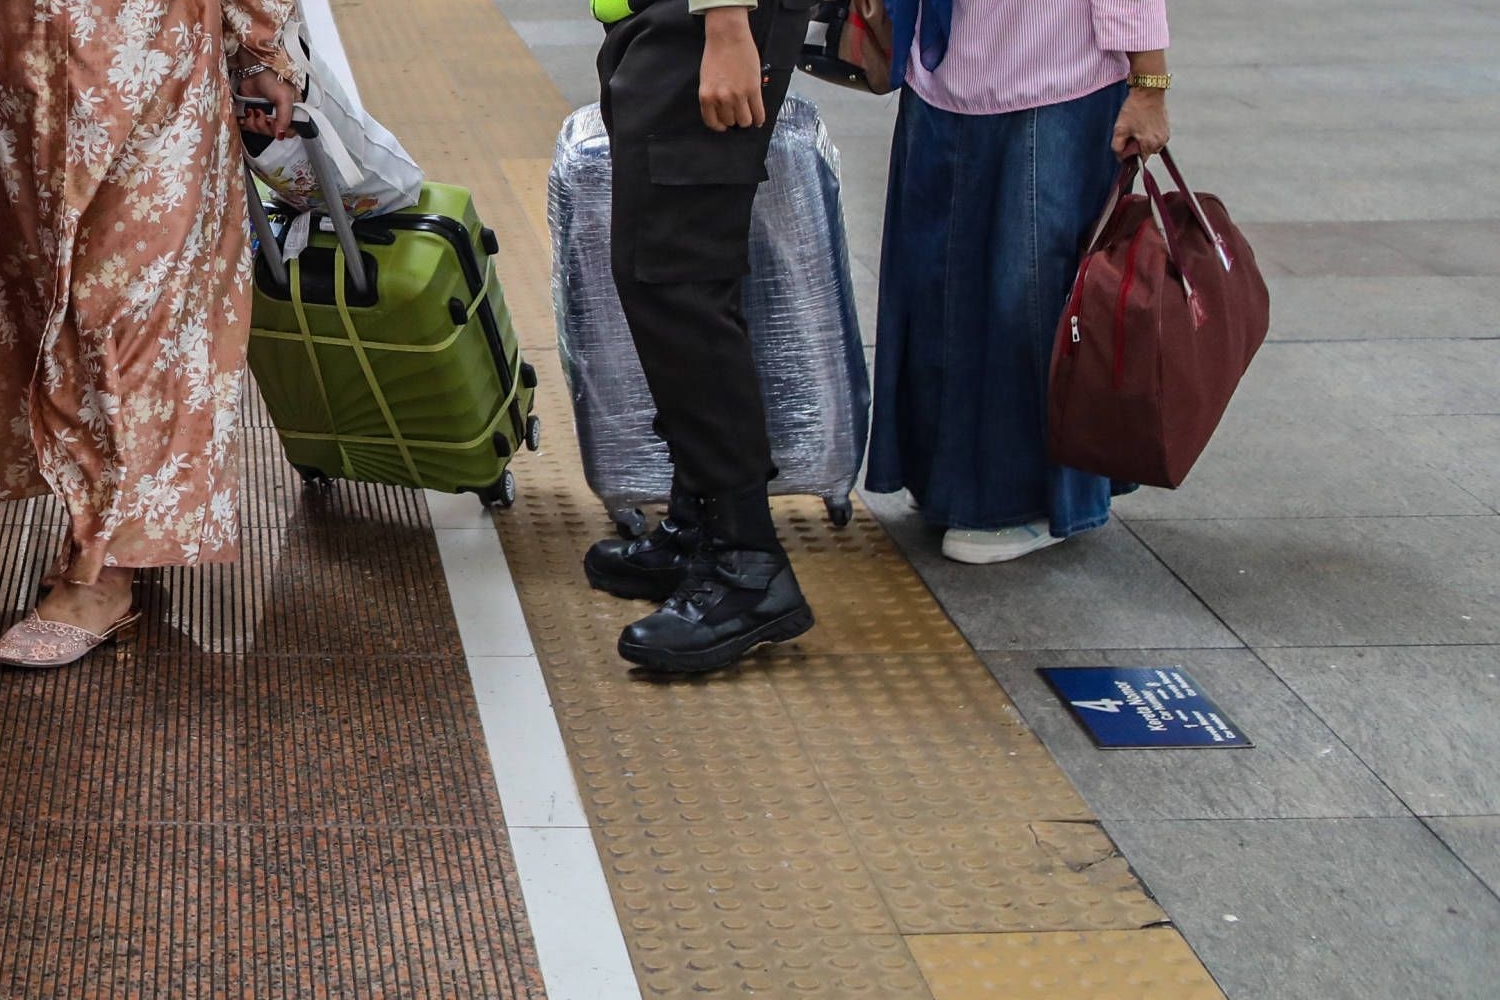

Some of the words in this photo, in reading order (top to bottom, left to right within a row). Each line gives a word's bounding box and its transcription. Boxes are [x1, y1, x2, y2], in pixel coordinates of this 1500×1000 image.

[1114, 681, 1147, 705] Nomor
[1071, 698, 1124, 713] 4
[1137, 706, 1168, 731] Kereta
